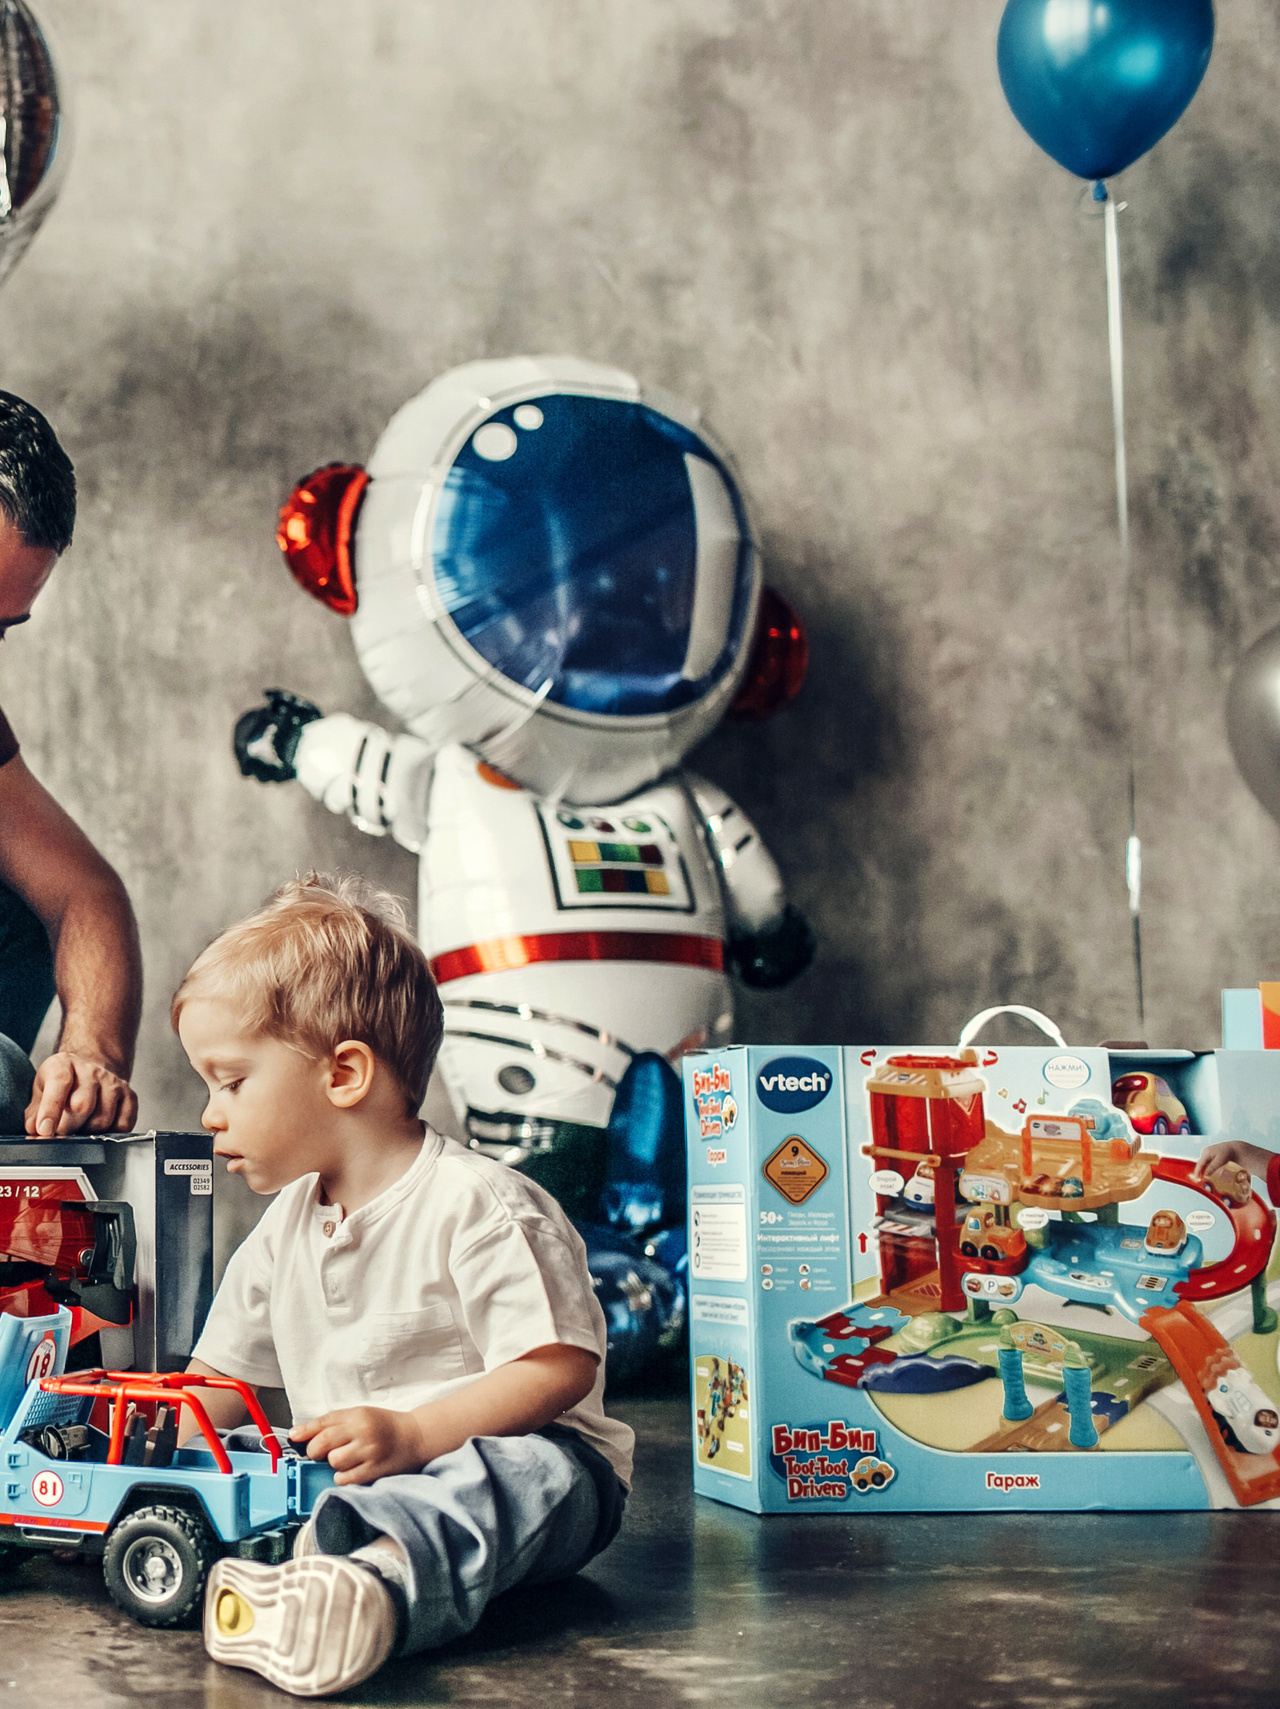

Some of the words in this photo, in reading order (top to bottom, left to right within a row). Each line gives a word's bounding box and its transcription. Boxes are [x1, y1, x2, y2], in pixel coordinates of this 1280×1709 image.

[791, 1146, 799, 1157] 9
[760, 1211, 784, 1224] 50+
[757, 1234, 818, 1243] Интерактивный
[820, 1234, 840, 1243] лифт
[773, 1422, 875, 1454] Бип-Бип
[784, 1456, 848, 1476] Toot-Toot
[39, 1480, 57, 1496] 81
[788, 1478, 846, 1498] Drivers
[986, 1473, 1039, 1491] Гараж
